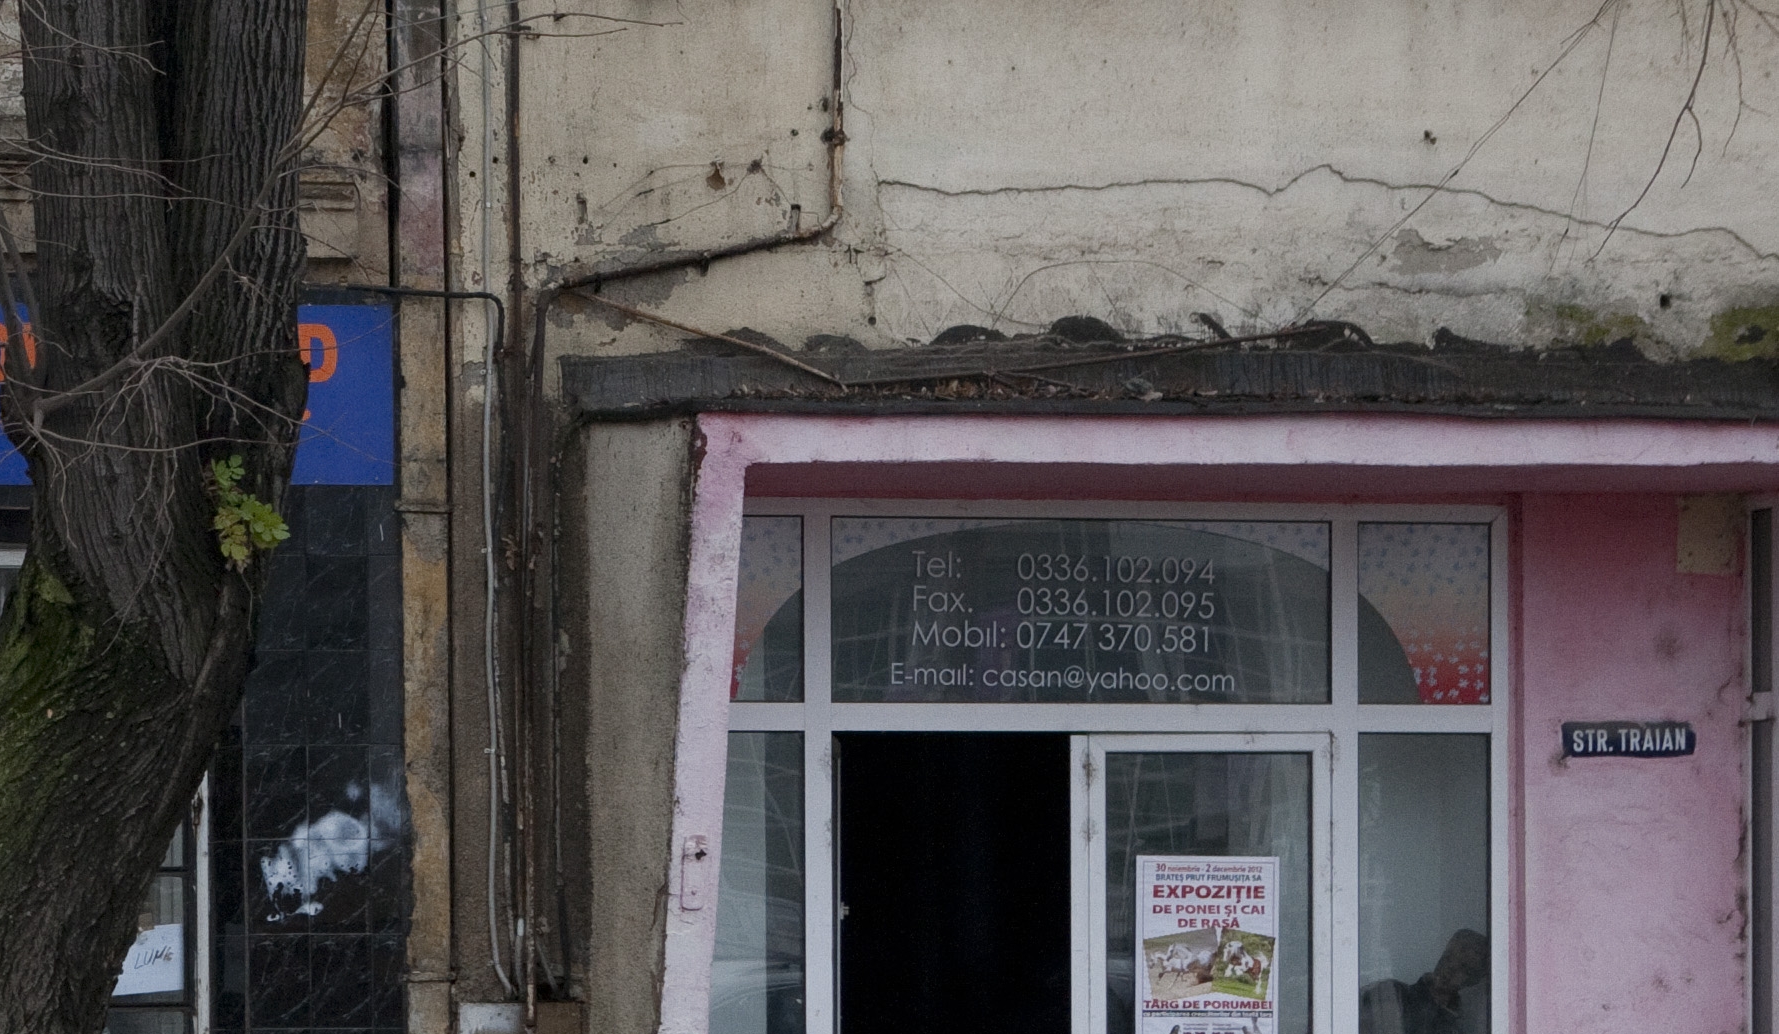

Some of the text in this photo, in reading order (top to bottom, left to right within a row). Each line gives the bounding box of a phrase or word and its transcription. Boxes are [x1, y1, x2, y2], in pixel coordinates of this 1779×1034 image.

[912, 551, 1215, 585] Tel: 0336.102.094
[912, 585, 1215, 620] Fax. 0336.102.095
[982, 664, 1235, 694] casan@yahoo.com
[1573, 728, 1686, 752] STR. TRAIAN
[1155, 863, 1166, 872] 30
[1152, 904, 1172, 914] DE
[1175, 905, 1221, 914] PONEI
[1240, 905, 1265, 915] CAI
[1177, 918, 1198, 928] DE
[1182, 1000, 1200, 1009] DE
[1203, 1000, 1272, 1010] PORUMBEI
